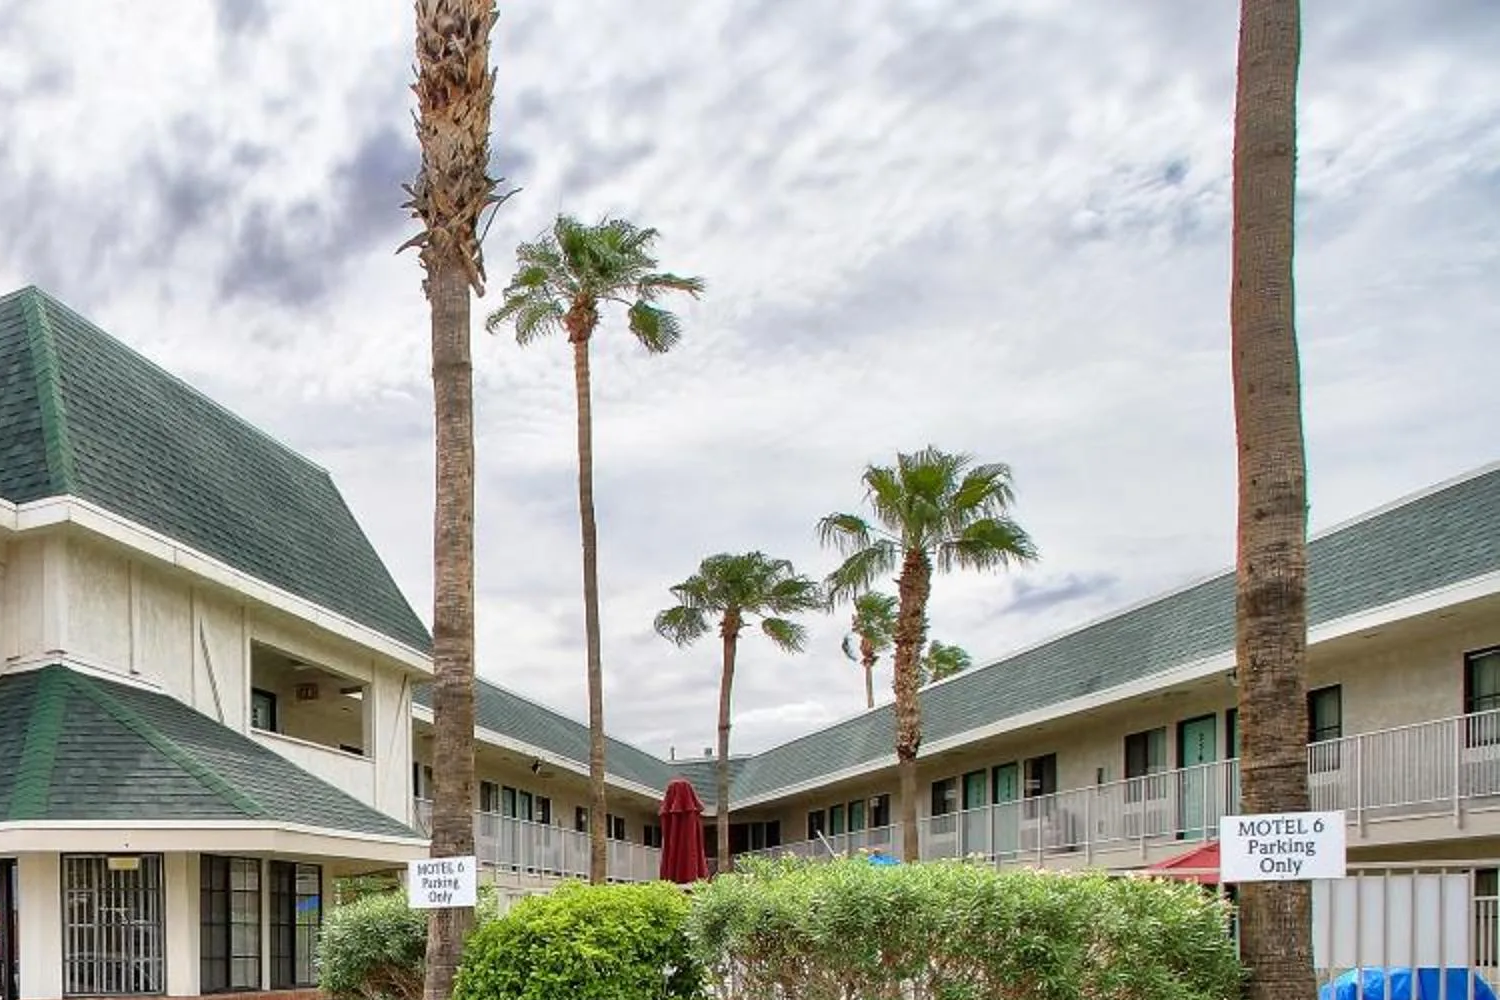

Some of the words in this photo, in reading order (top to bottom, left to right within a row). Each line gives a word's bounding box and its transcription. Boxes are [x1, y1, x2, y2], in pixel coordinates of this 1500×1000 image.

[1238, 819, 1308, 837] MOTEL
[1313, 817, 1325, 834] 6
[1248, 838, 1317, 857] Parking
[417, 861, 455, 876] MOTEL
[457, 861, 465, 874] 6
[1259, 857, 1303, 876] Only
[421, 875, 461, 890] Parking
[427, 891, 453, 904] Only
